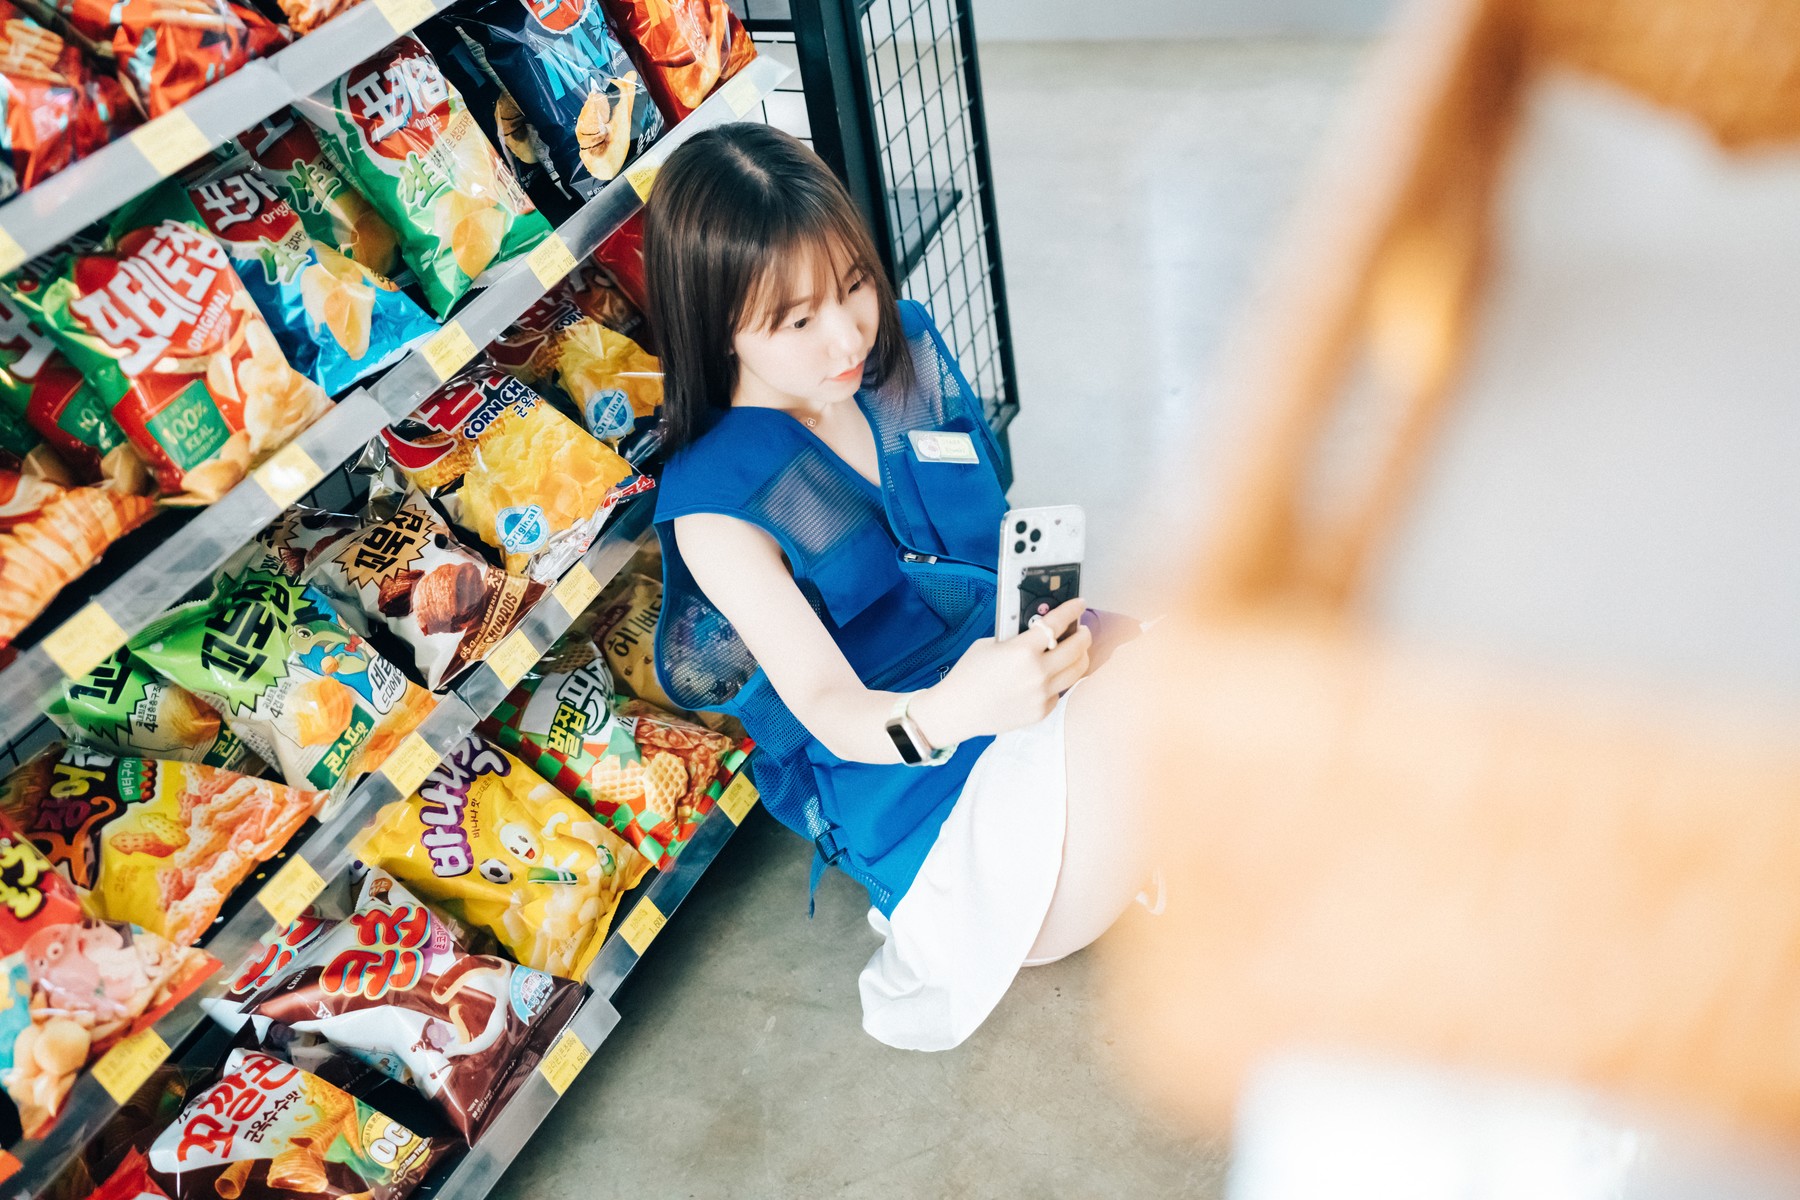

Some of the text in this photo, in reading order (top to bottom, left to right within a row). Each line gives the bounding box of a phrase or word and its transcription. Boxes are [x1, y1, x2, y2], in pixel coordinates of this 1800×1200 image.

[415, 110, 440, 131] Onion
[70, 219, 229, 377] 포테토칩
[187, 289, 232, 350] ORIGINAL
[462, 399, 503, 440] CORN
[595, 391, 625, 436] Original
[507, 507, 540, 549] Original
[201, 579, 292, 684] 꼬북칩
[549, 702, 588, 758] 벌집
[322, 904, 431, 997] 콘초
[176, 1053, 299, 1163] 꼬깔콘
[244, 1090, 301, 1144] 군옥수수맛
